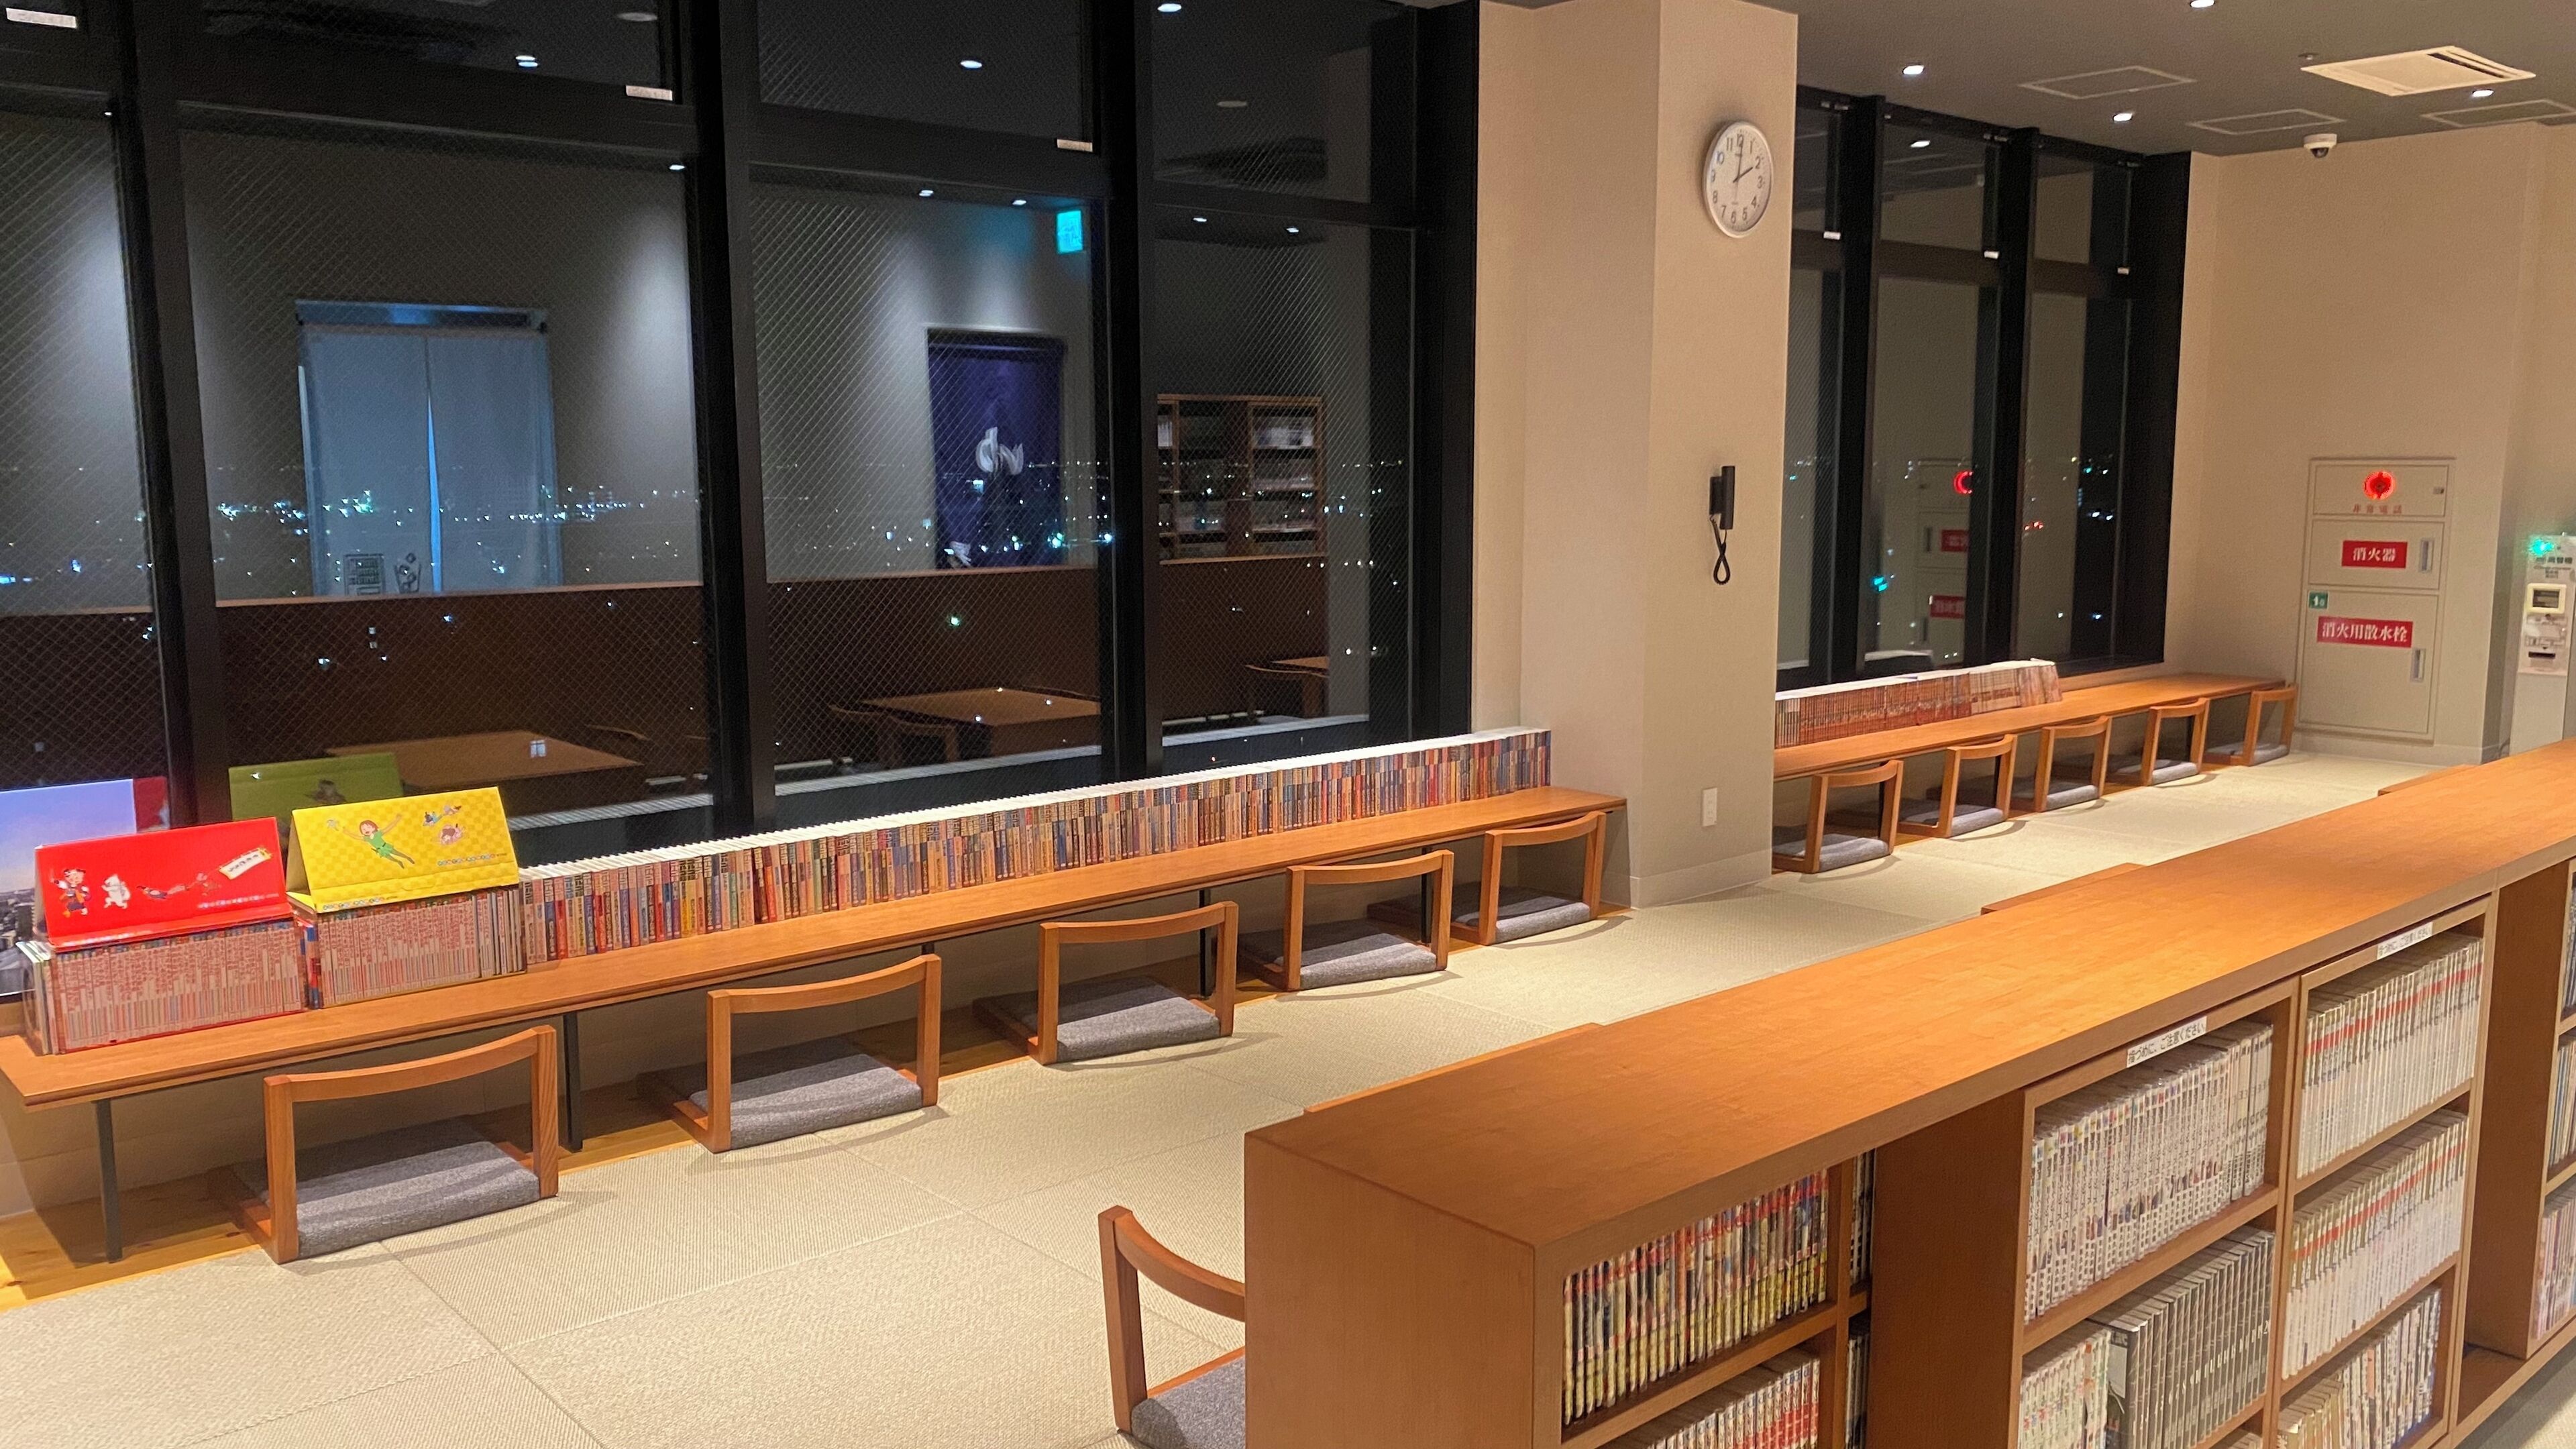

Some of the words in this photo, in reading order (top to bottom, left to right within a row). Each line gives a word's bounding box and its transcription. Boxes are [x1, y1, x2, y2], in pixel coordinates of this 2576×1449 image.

[1727, 138, 1733, 152] 11
[1737, 133, 1743, 147] 12
[1717, 151, 1724, 164] 10
[1755, 156, 1761, 169] 2
[1758, 175, 1763, 189] 3
[1713, 191, 1717, 203] 8
[1751, 195, 1757, 209] 4
[1721, 205, 1727, 218] 7
[1731, 211, 1736, 224] 6
[1742, 207, 1748, 221] 5
[2353, 547, 2396, 561] 消火器
[2322, 623, 2408, 642] 消火用散水栓
